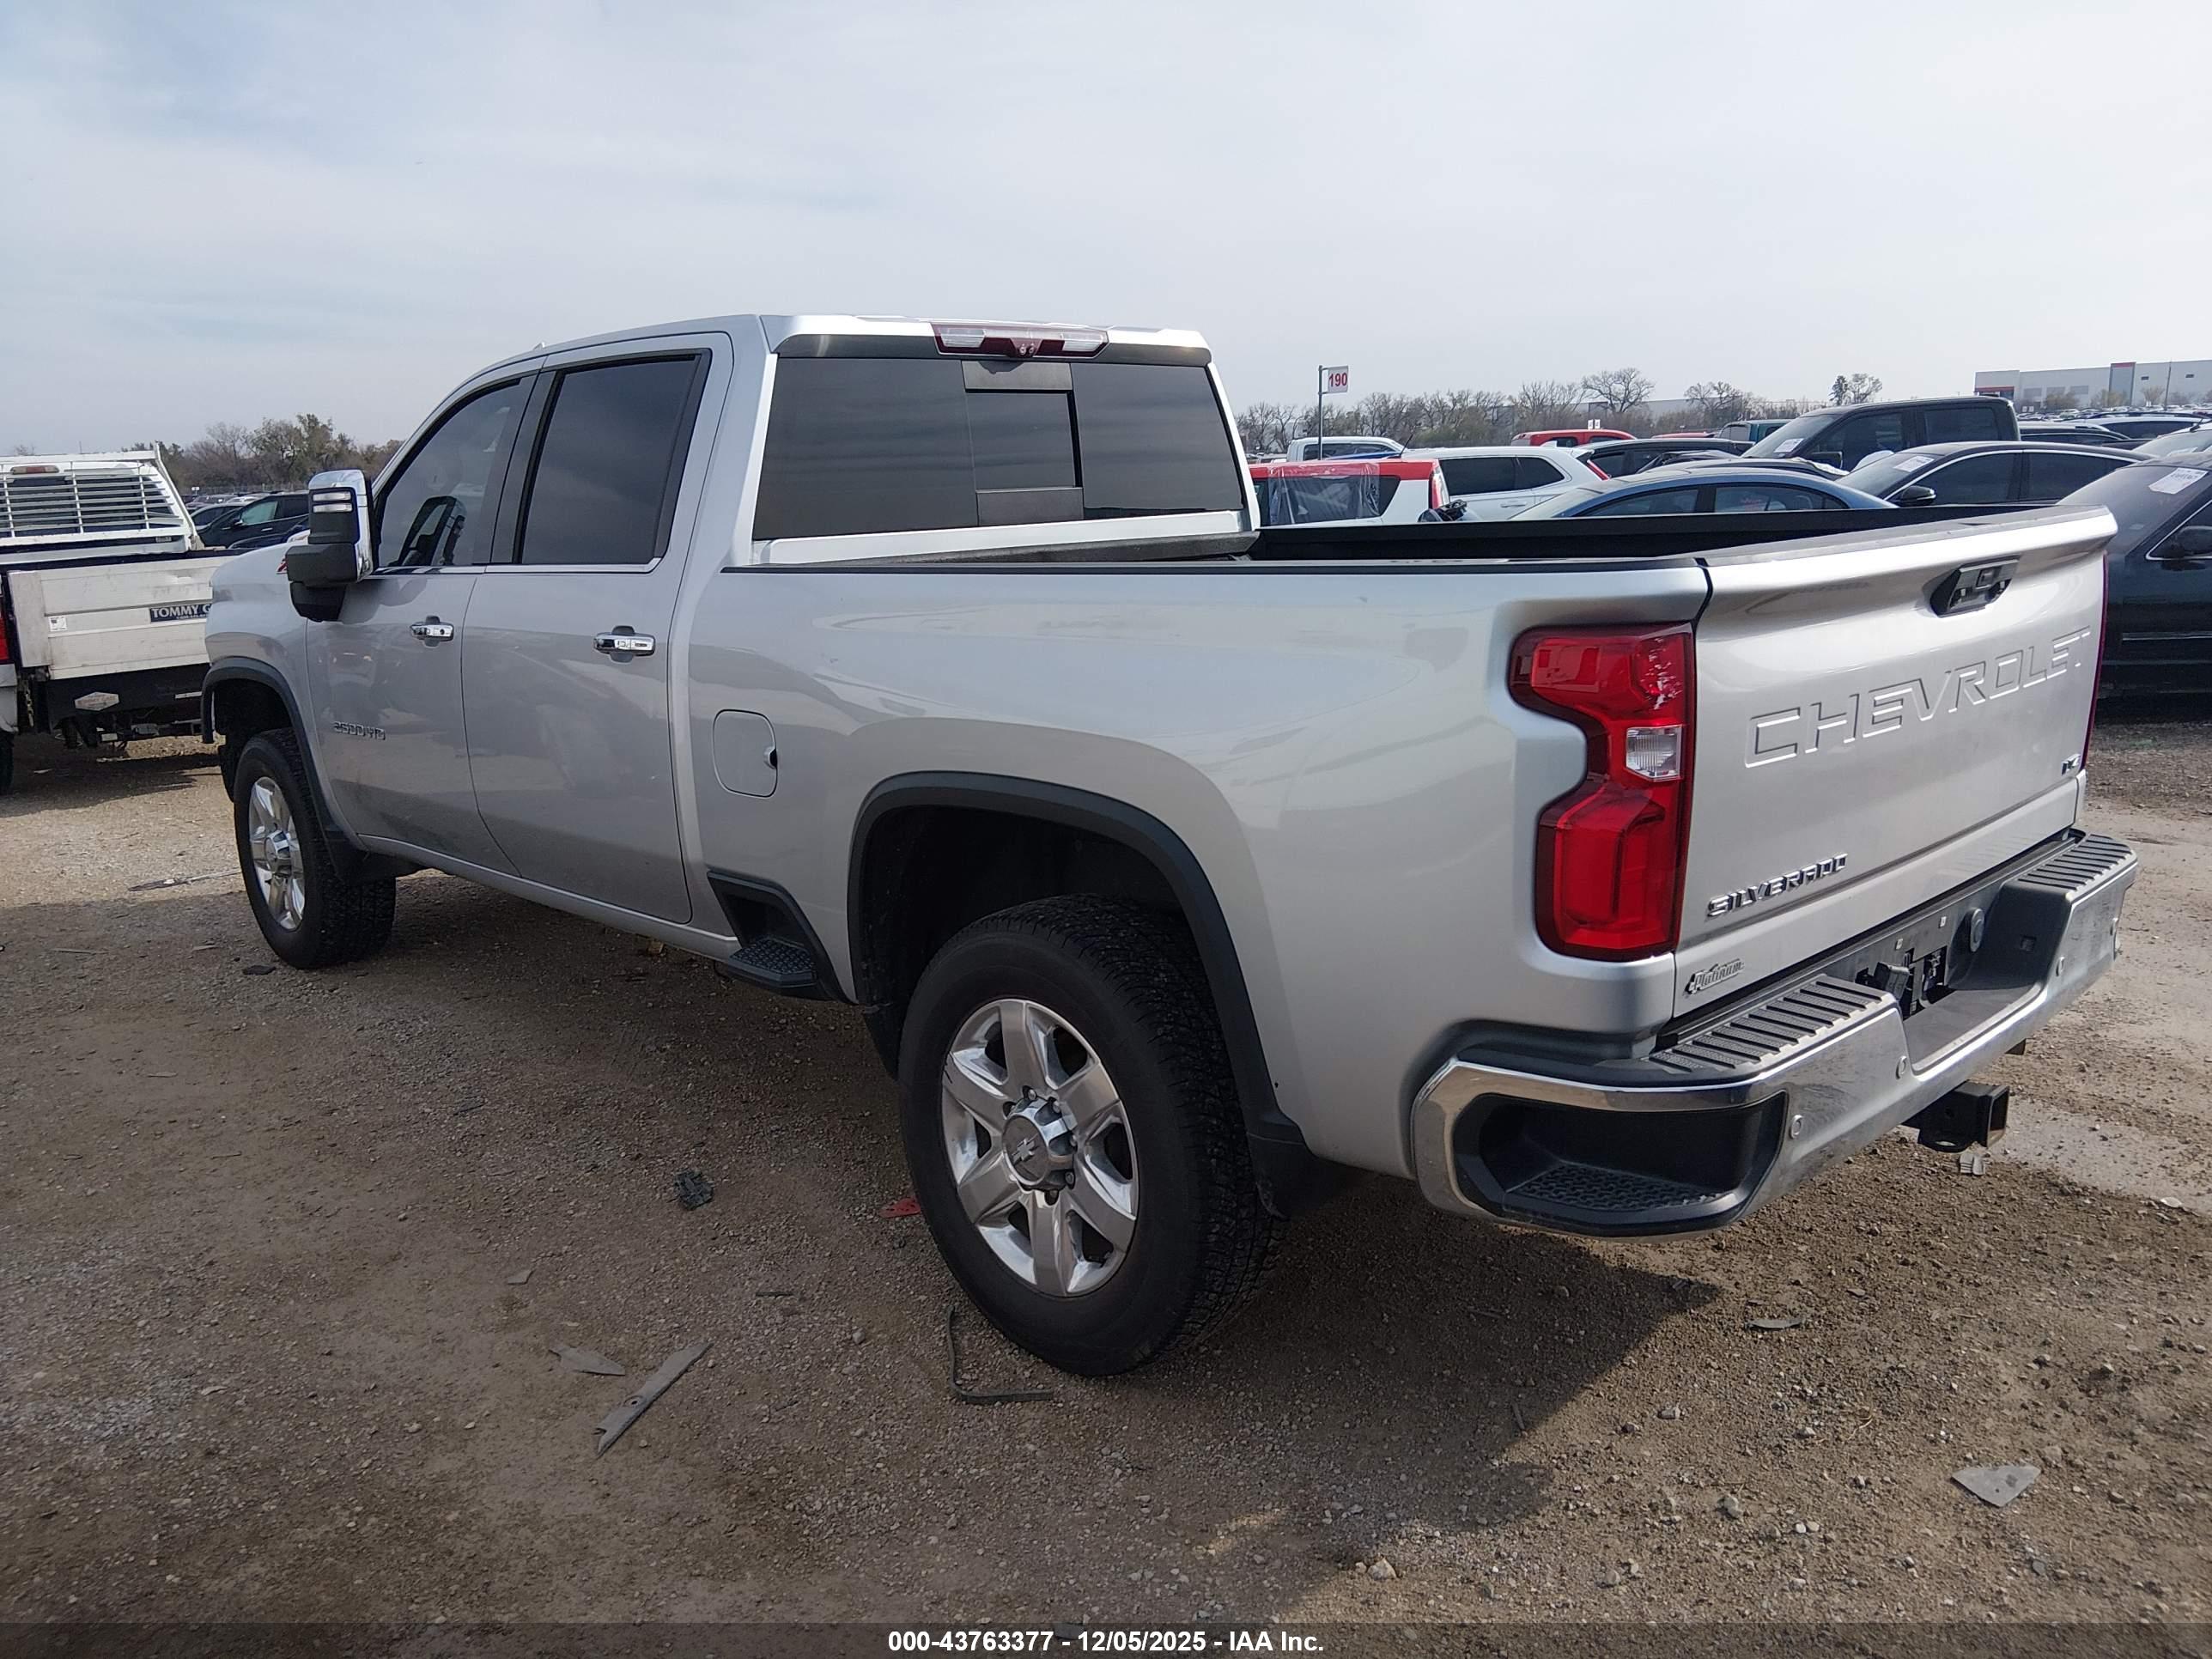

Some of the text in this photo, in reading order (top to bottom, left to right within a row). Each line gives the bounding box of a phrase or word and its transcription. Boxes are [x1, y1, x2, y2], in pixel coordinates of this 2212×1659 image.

[1328, 372, 1348, 387] 190
[151, 605, 199, 619] TOMMY
[1744, 625, 2092, 769] CHEVROLET
[1705, 853, 1848, 918] SILVERADO
